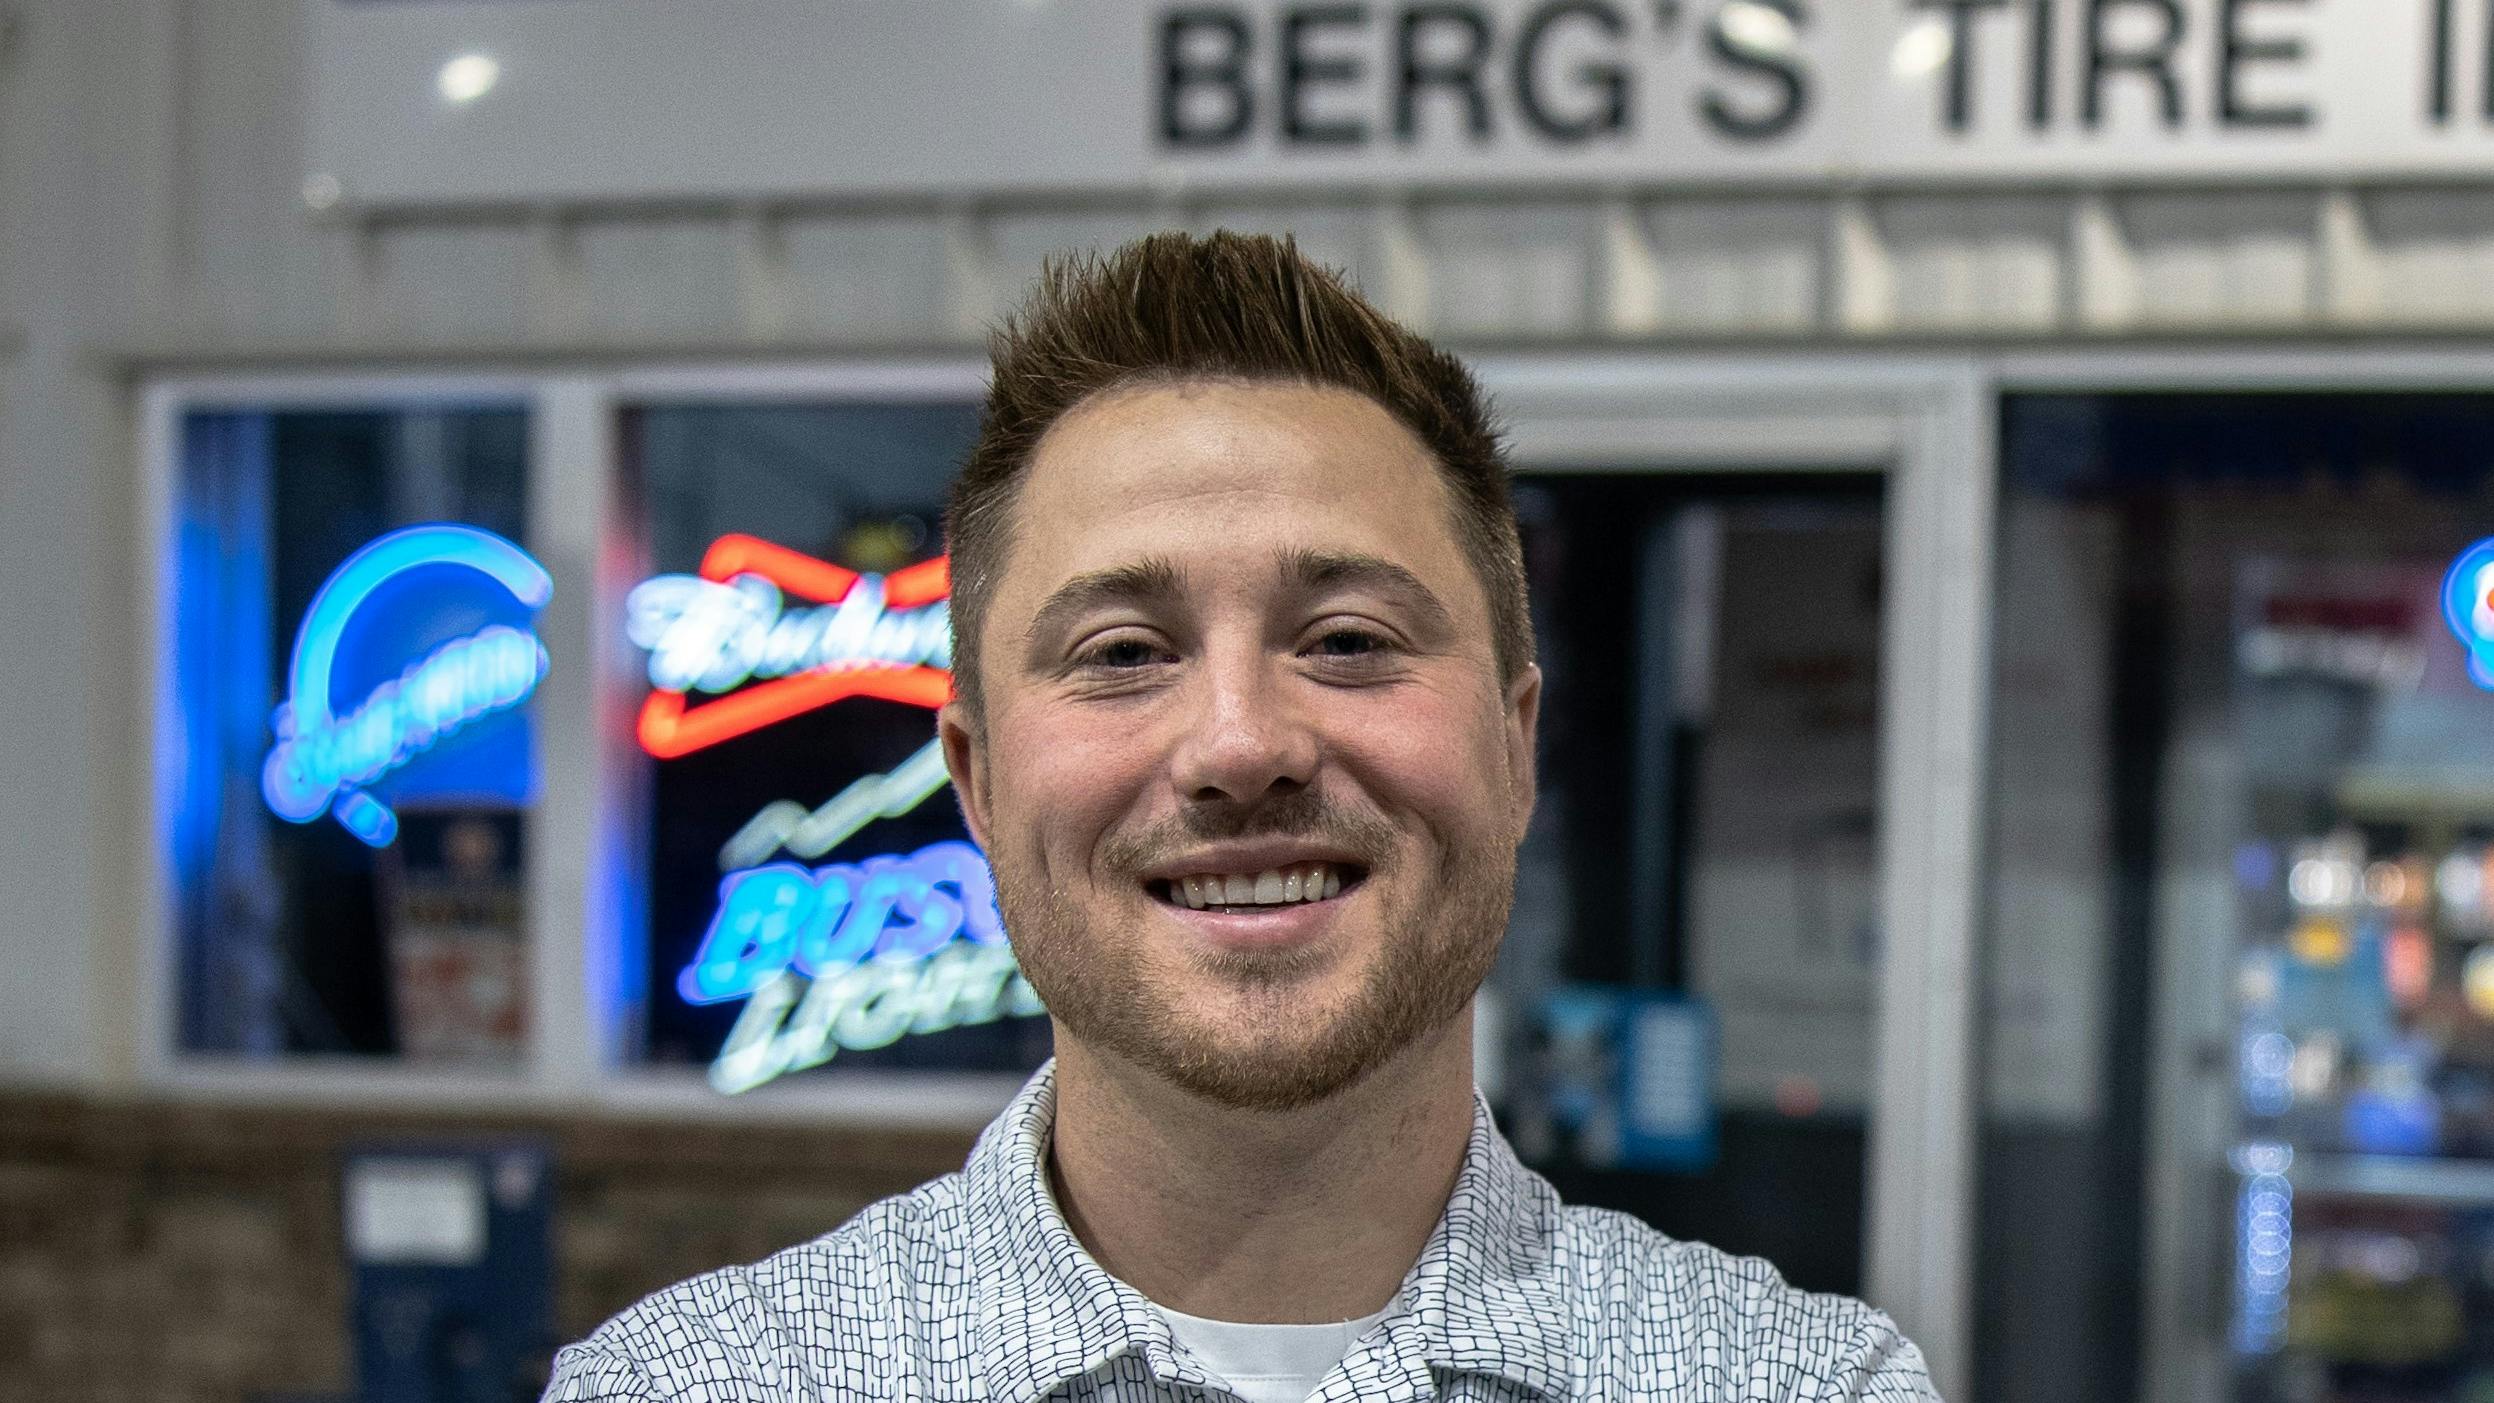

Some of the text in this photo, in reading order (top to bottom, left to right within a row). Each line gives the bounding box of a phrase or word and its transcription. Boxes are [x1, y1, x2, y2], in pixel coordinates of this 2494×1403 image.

[1155, 0, 2494, 148] BERG'S TIRE I
